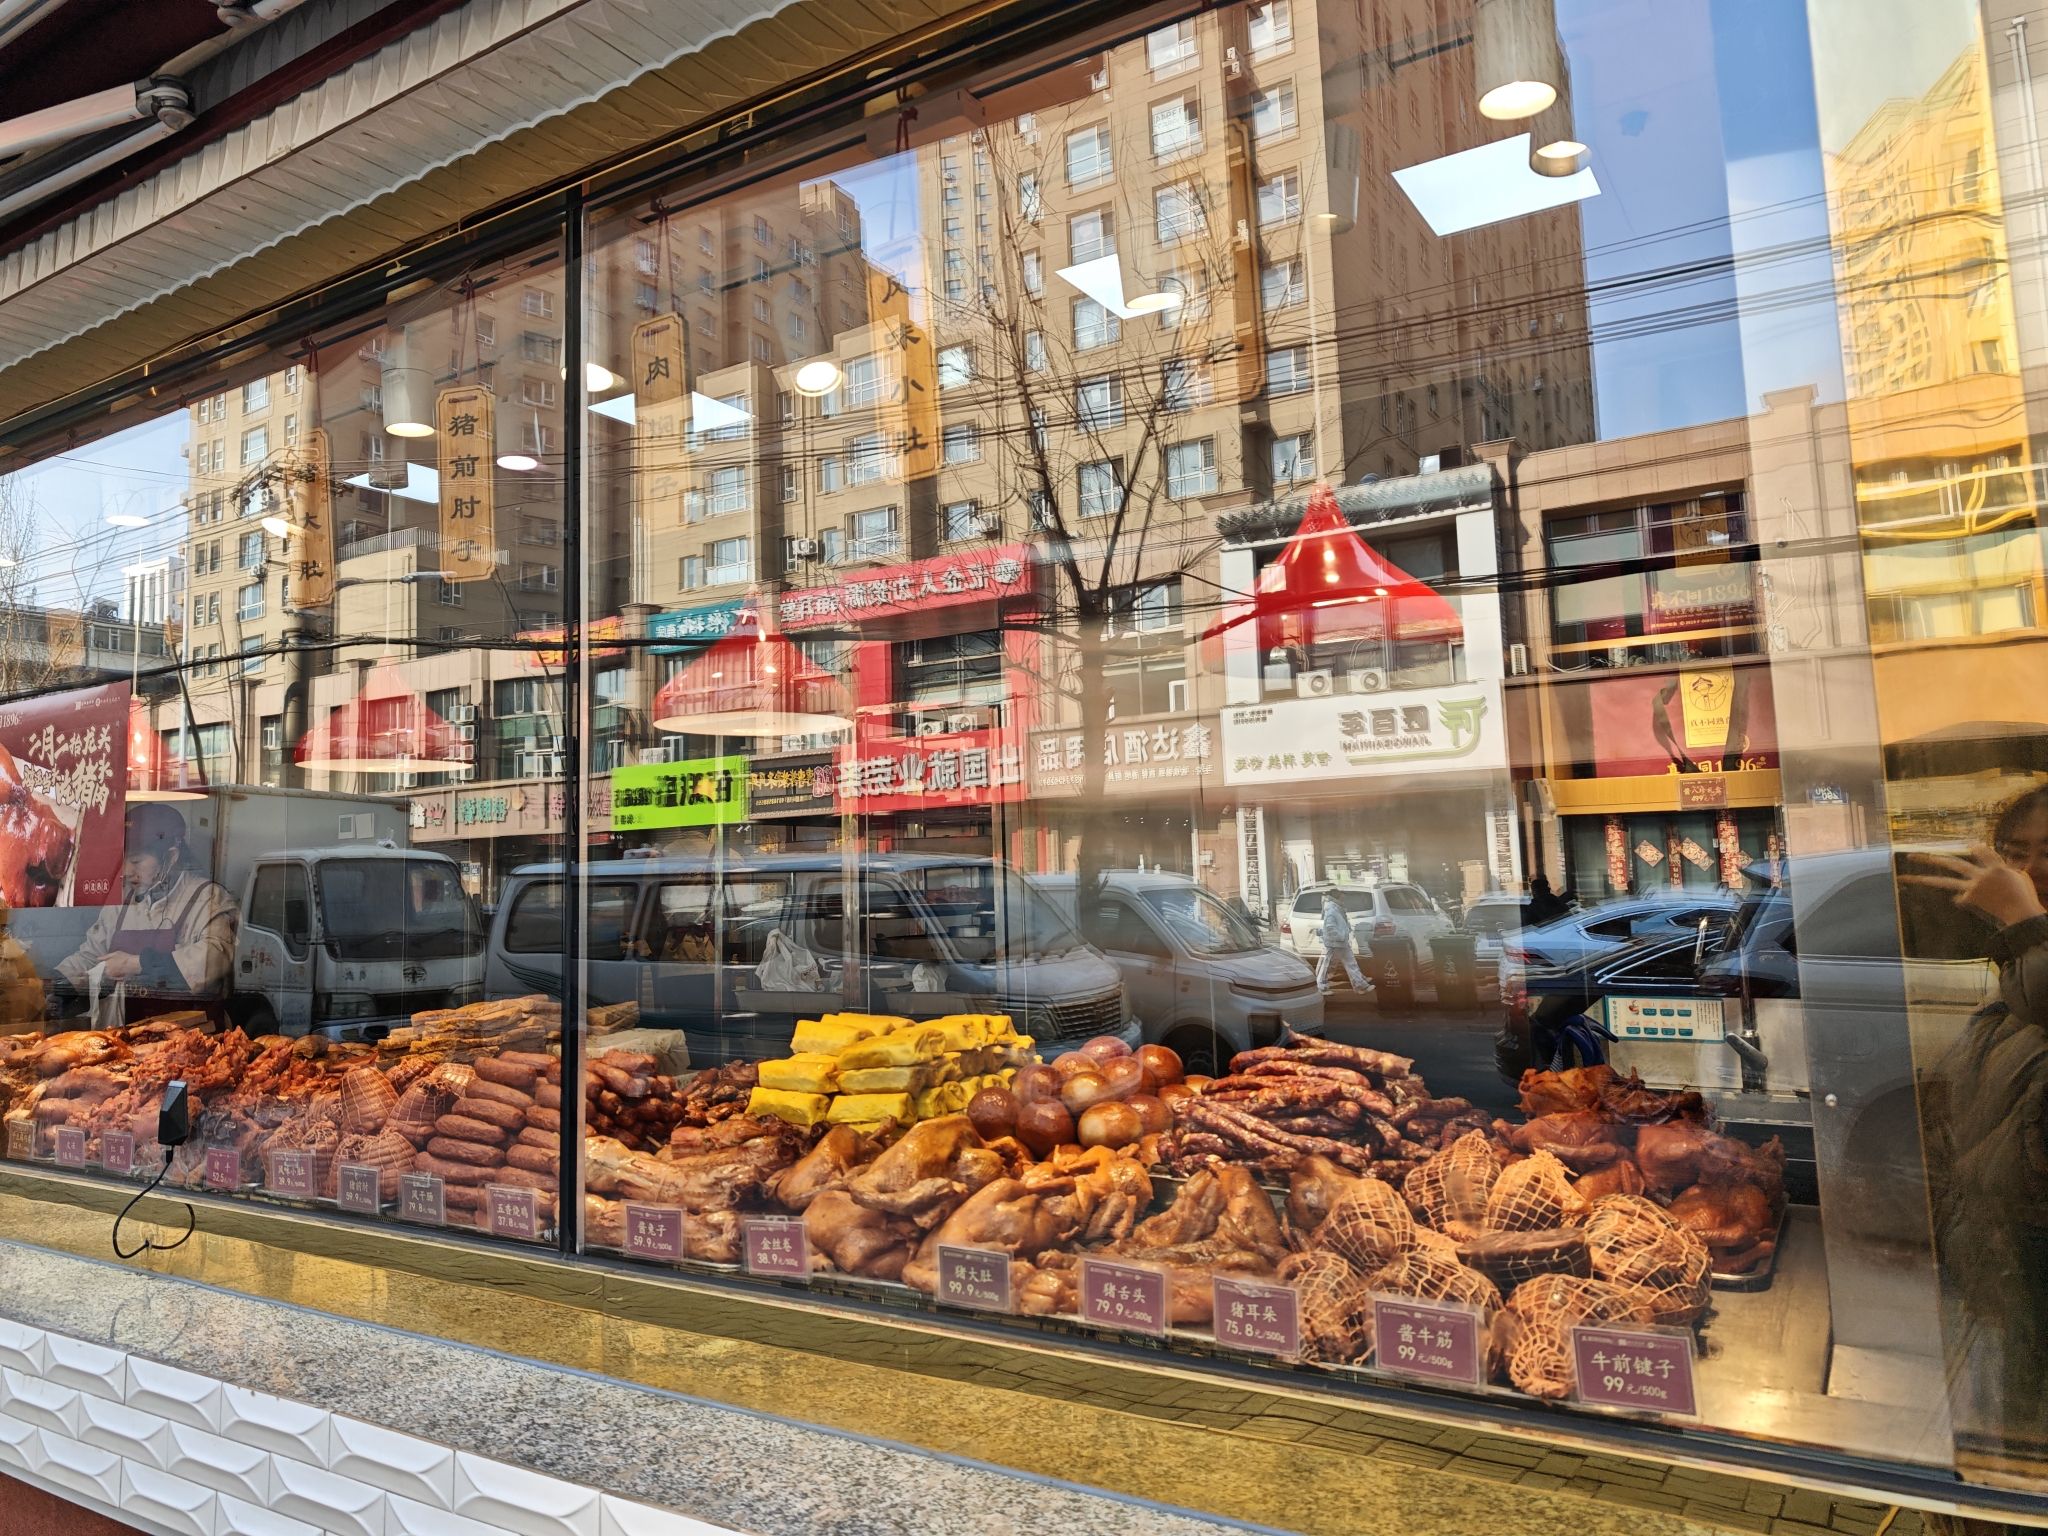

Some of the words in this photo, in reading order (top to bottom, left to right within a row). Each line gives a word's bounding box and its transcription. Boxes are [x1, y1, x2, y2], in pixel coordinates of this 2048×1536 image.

[447, 412, 481, 563] 猪前肘子
[496, 1203, 529, 1219] 五香烧鸡
[955, 1264, 994, 1283] 猪大肚
[1103, 1282, 1146, 1304] 猪舌头
[1230, 1300, 1278, 1323] 猪耳朵
[1396, 1323, 1453, 1350] 酱牛筋
[1590, 1350, 1676, 1379] 牛前键子
